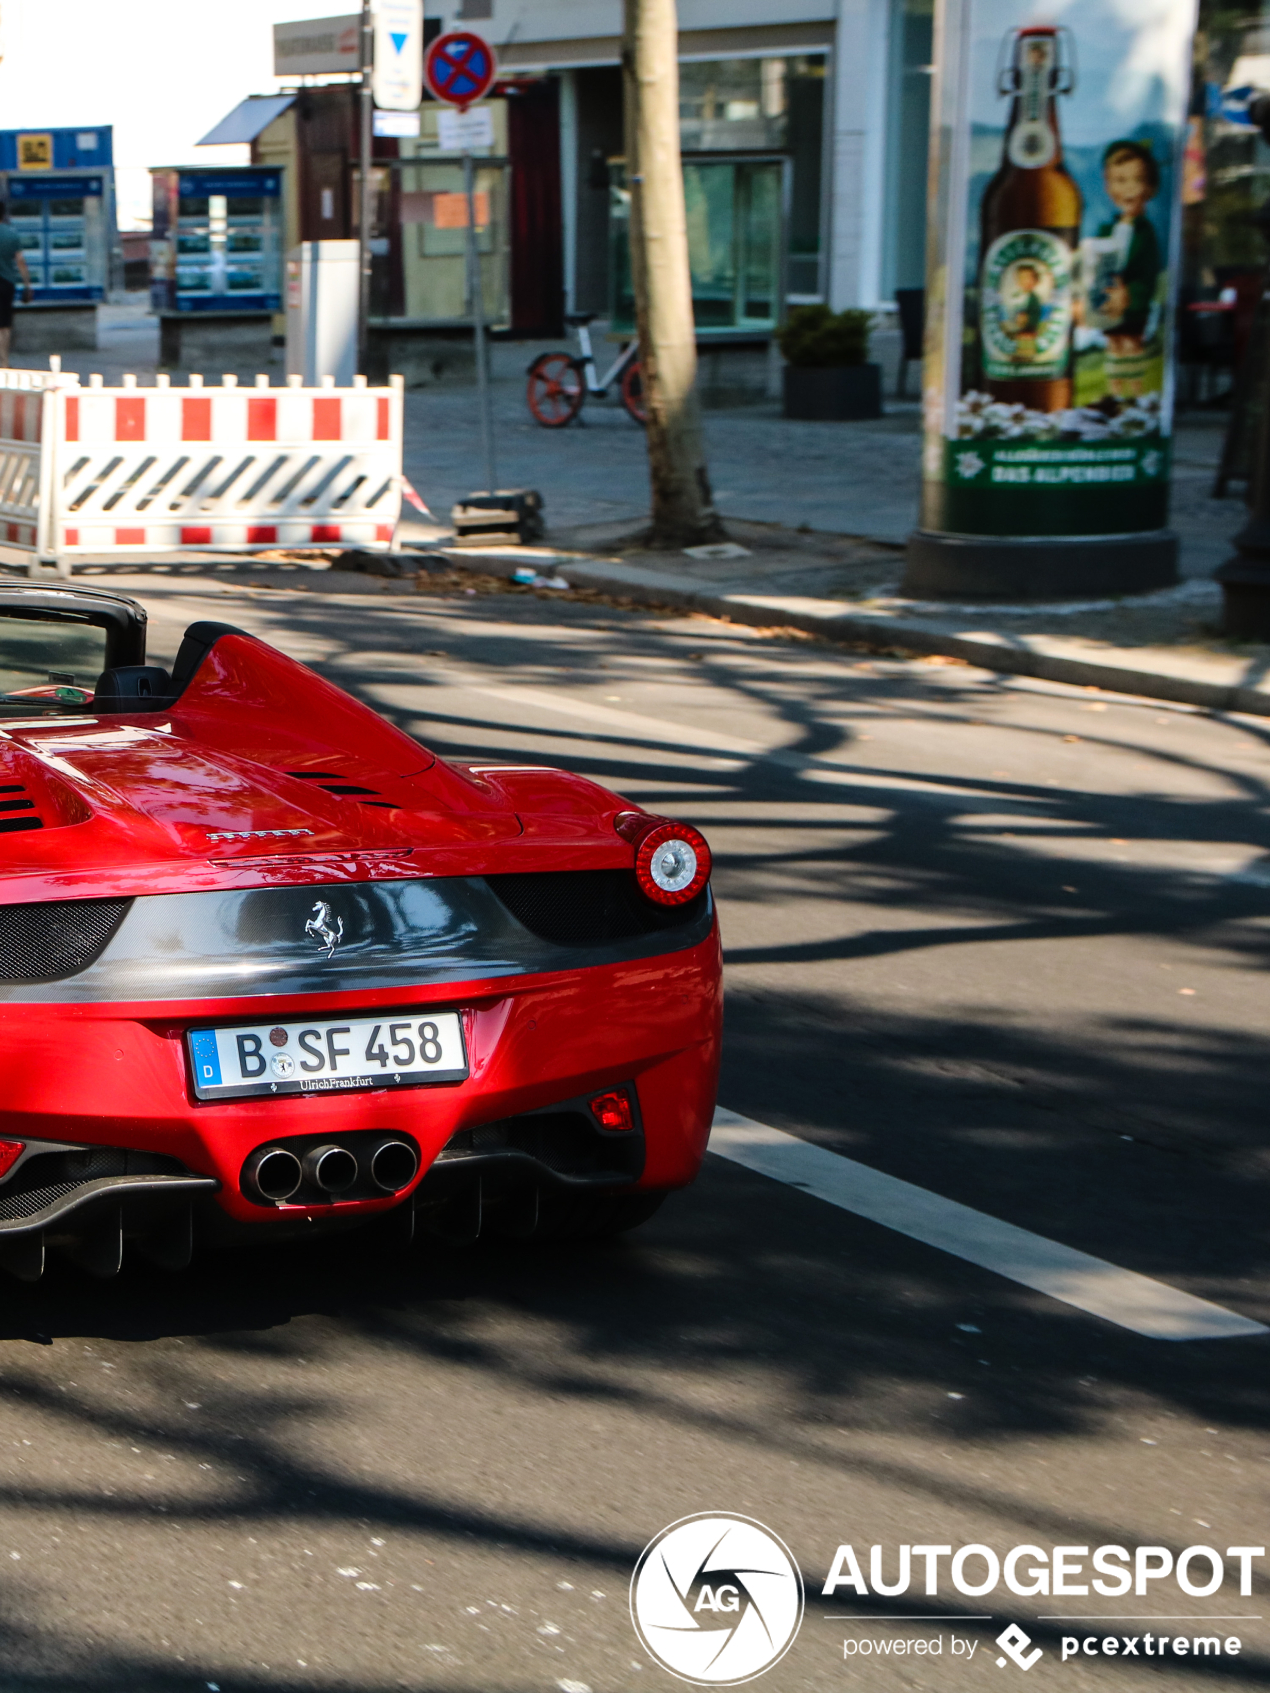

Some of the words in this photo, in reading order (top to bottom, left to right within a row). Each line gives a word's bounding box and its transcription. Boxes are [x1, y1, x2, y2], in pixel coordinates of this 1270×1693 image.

[236, 1033, 267, 1078] B
[298, 1027, 351, 1072] SF
[365, 1021, 443, 1068] 458
[203, 1065, 214, 1078] D
